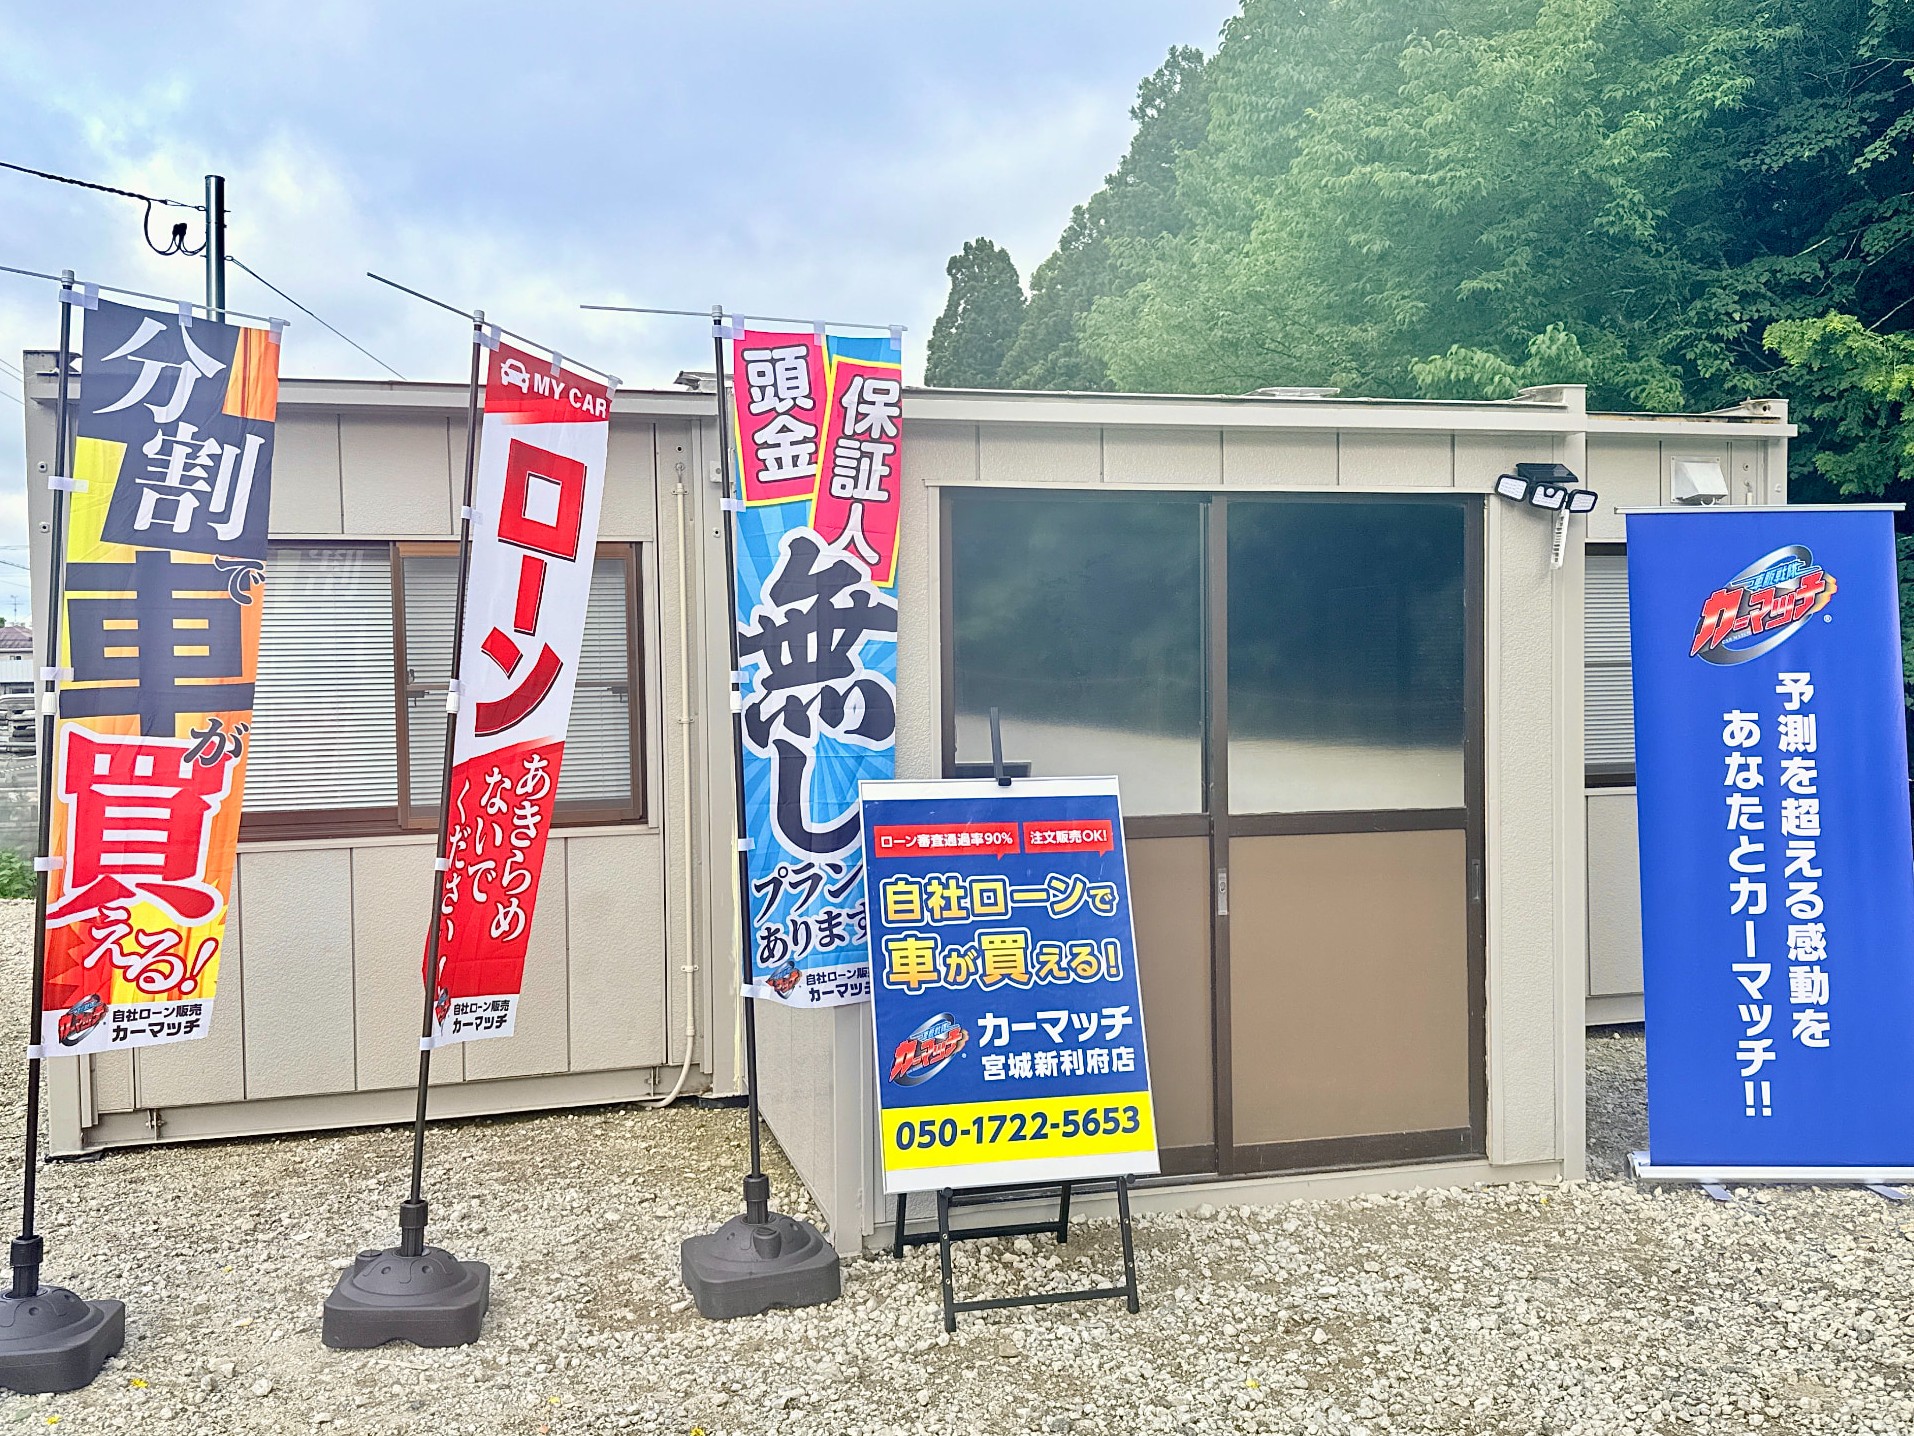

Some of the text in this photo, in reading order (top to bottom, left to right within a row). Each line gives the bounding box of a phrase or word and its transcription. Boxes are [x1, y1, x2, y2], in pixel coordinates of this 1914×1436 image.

[533, 372, 607, 419] MY CAR
[743, 345, 817, 482] 頭金
[827, 376, 900, 564] 保証人
[475, 438, 588, 737] ローン
[1689, 570, 1826, 657] カーマッチ
[739, 536, 898, 853] 無し
[468, 767, 512, 902] ないで
[490, 754, 550, 942] あきらめ
[880, 831, 1013, 848] ローン審査通過率90%
[1030, 829, 1107, 845] 注文販売OK!
[1775, 672, 1831, 1048] 予測を超える感動を
[753, 862, 863, 923] プラン
[883, 875, 1116, 924] 自社ローンで
[1722, 709, 1776, 1116] あなたとカーマッチ!!
[806, 967, 869, 986] 自社ローン販
[885, 932, 1120, 991] 車が買える!
[112, 1003, 202, 1023] 自社ローン販売
[112, 1018, 201, 1042] カーマッチ
[453, 1013, 508, 1034] カーマッチ
[454, 1000, 510, 1016] 自社ローン販売
[978, 1005, 1133, 1048] カーマッチ
[981, 1047, 1135, 1081] 宮城新利府店
[896, 1105, 1140, 1151] 050-1722-5653
